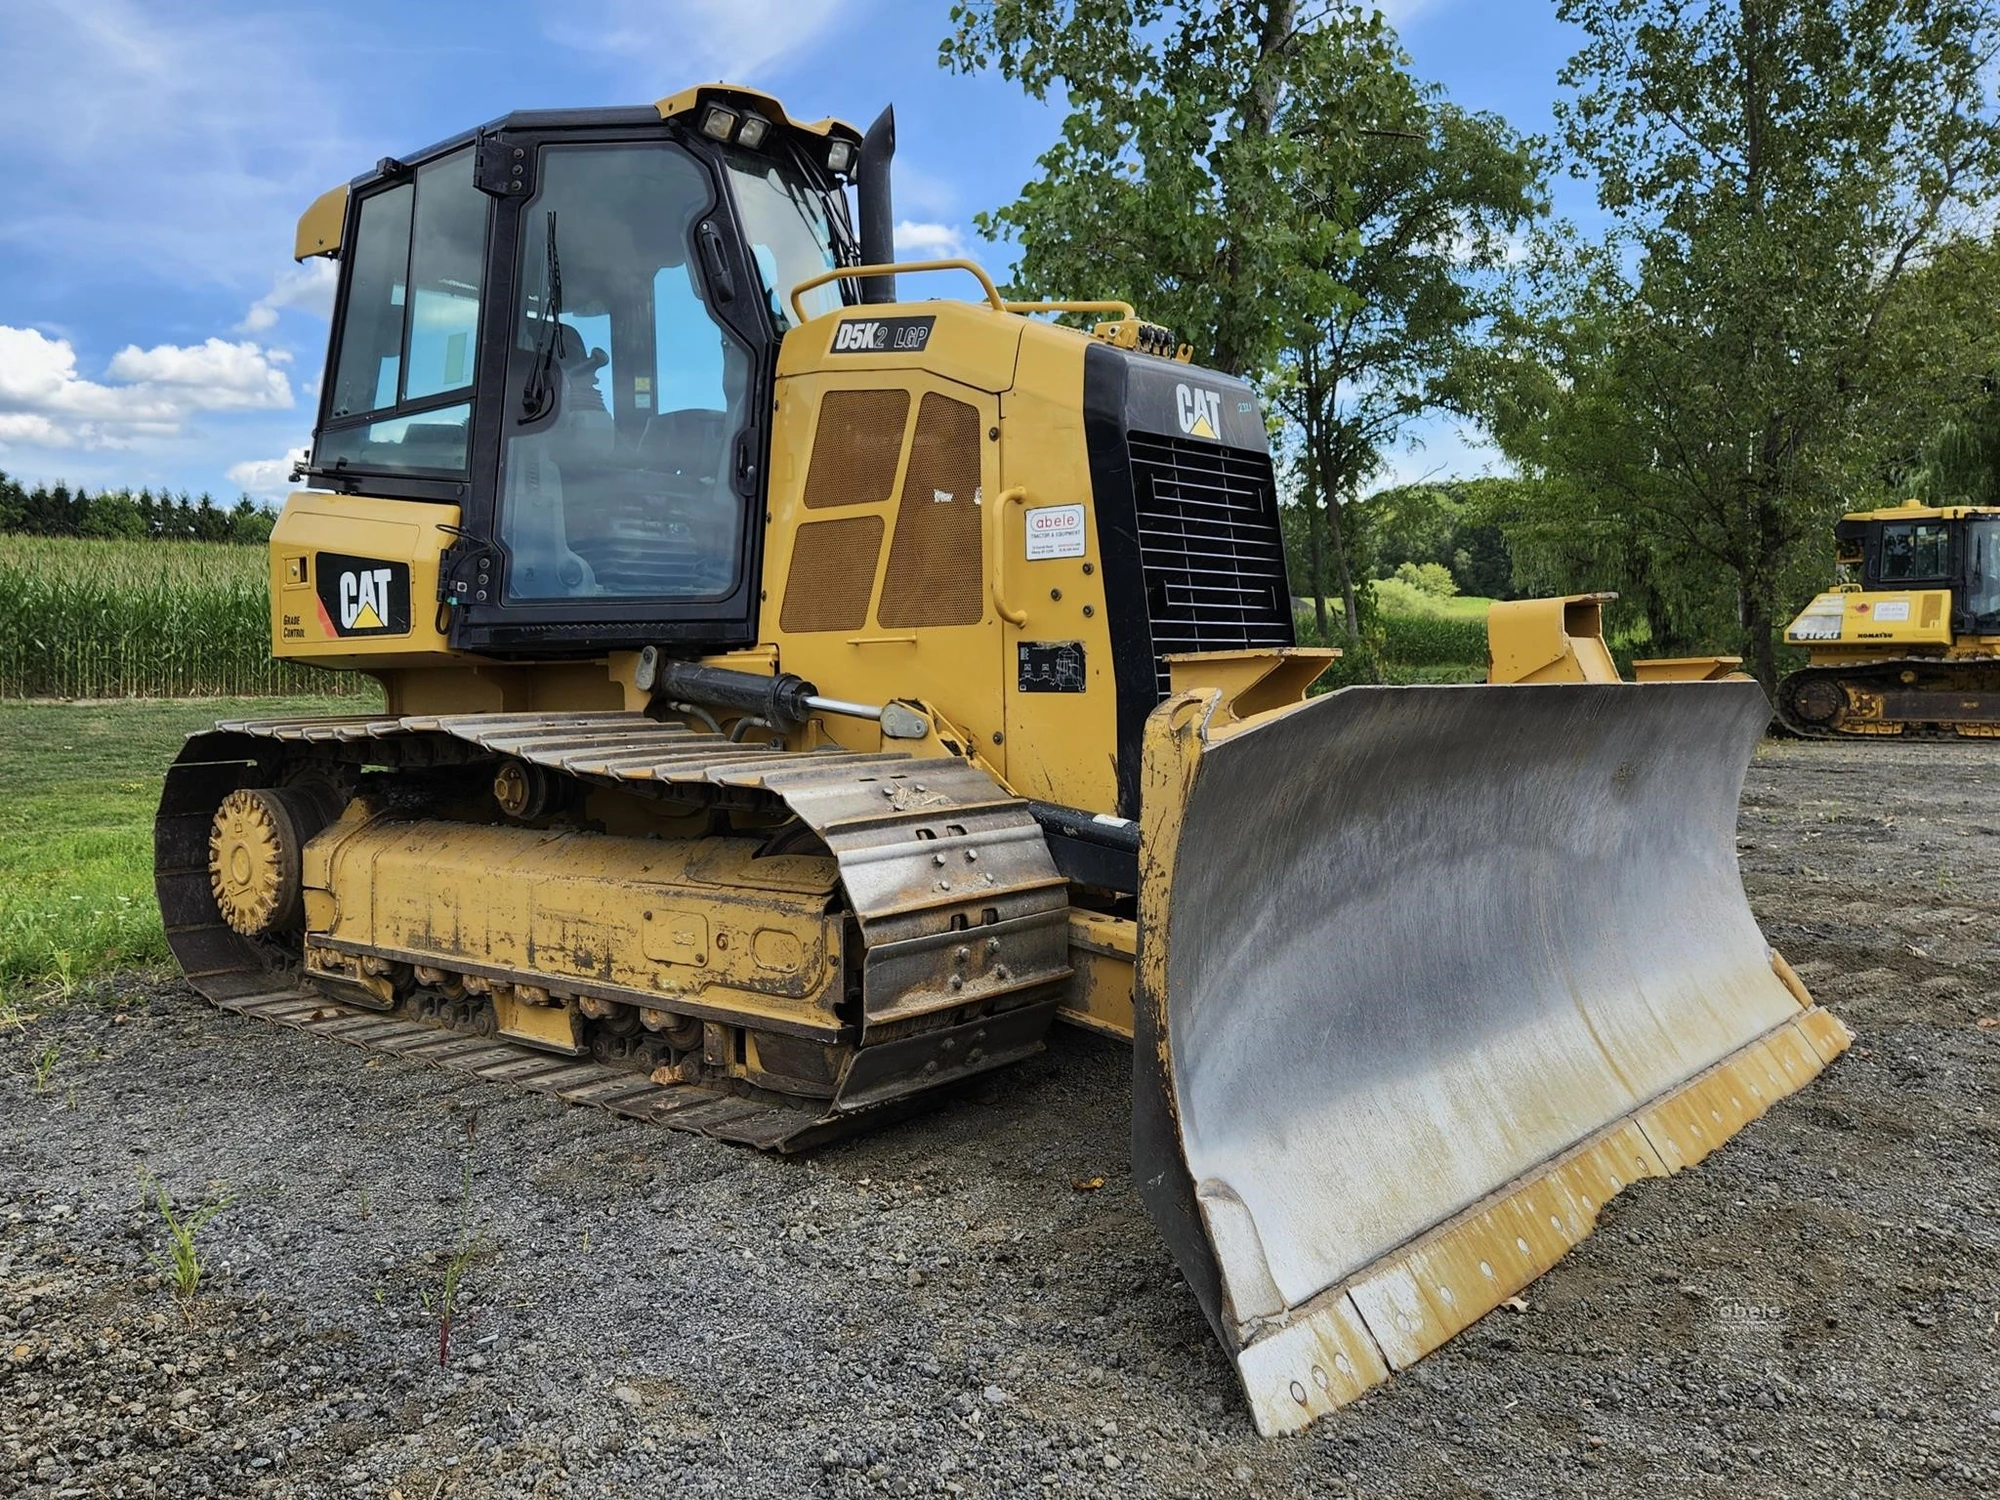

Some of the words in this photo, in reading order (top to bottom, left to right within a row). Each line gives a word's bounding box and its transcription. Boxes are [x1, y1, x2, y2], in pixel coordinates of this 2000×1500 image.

[835, 322, 887, 350] D5K2
[893, 326, 929, 348] LGP
[1176, 383, 1221, 440] CAT
[1036, 513, 1074, 529] abele
[340, 568, 392, 629] CAT
[283, 615, 300, 626] GRADE
[283, 627, 305, 638] CONTROL
